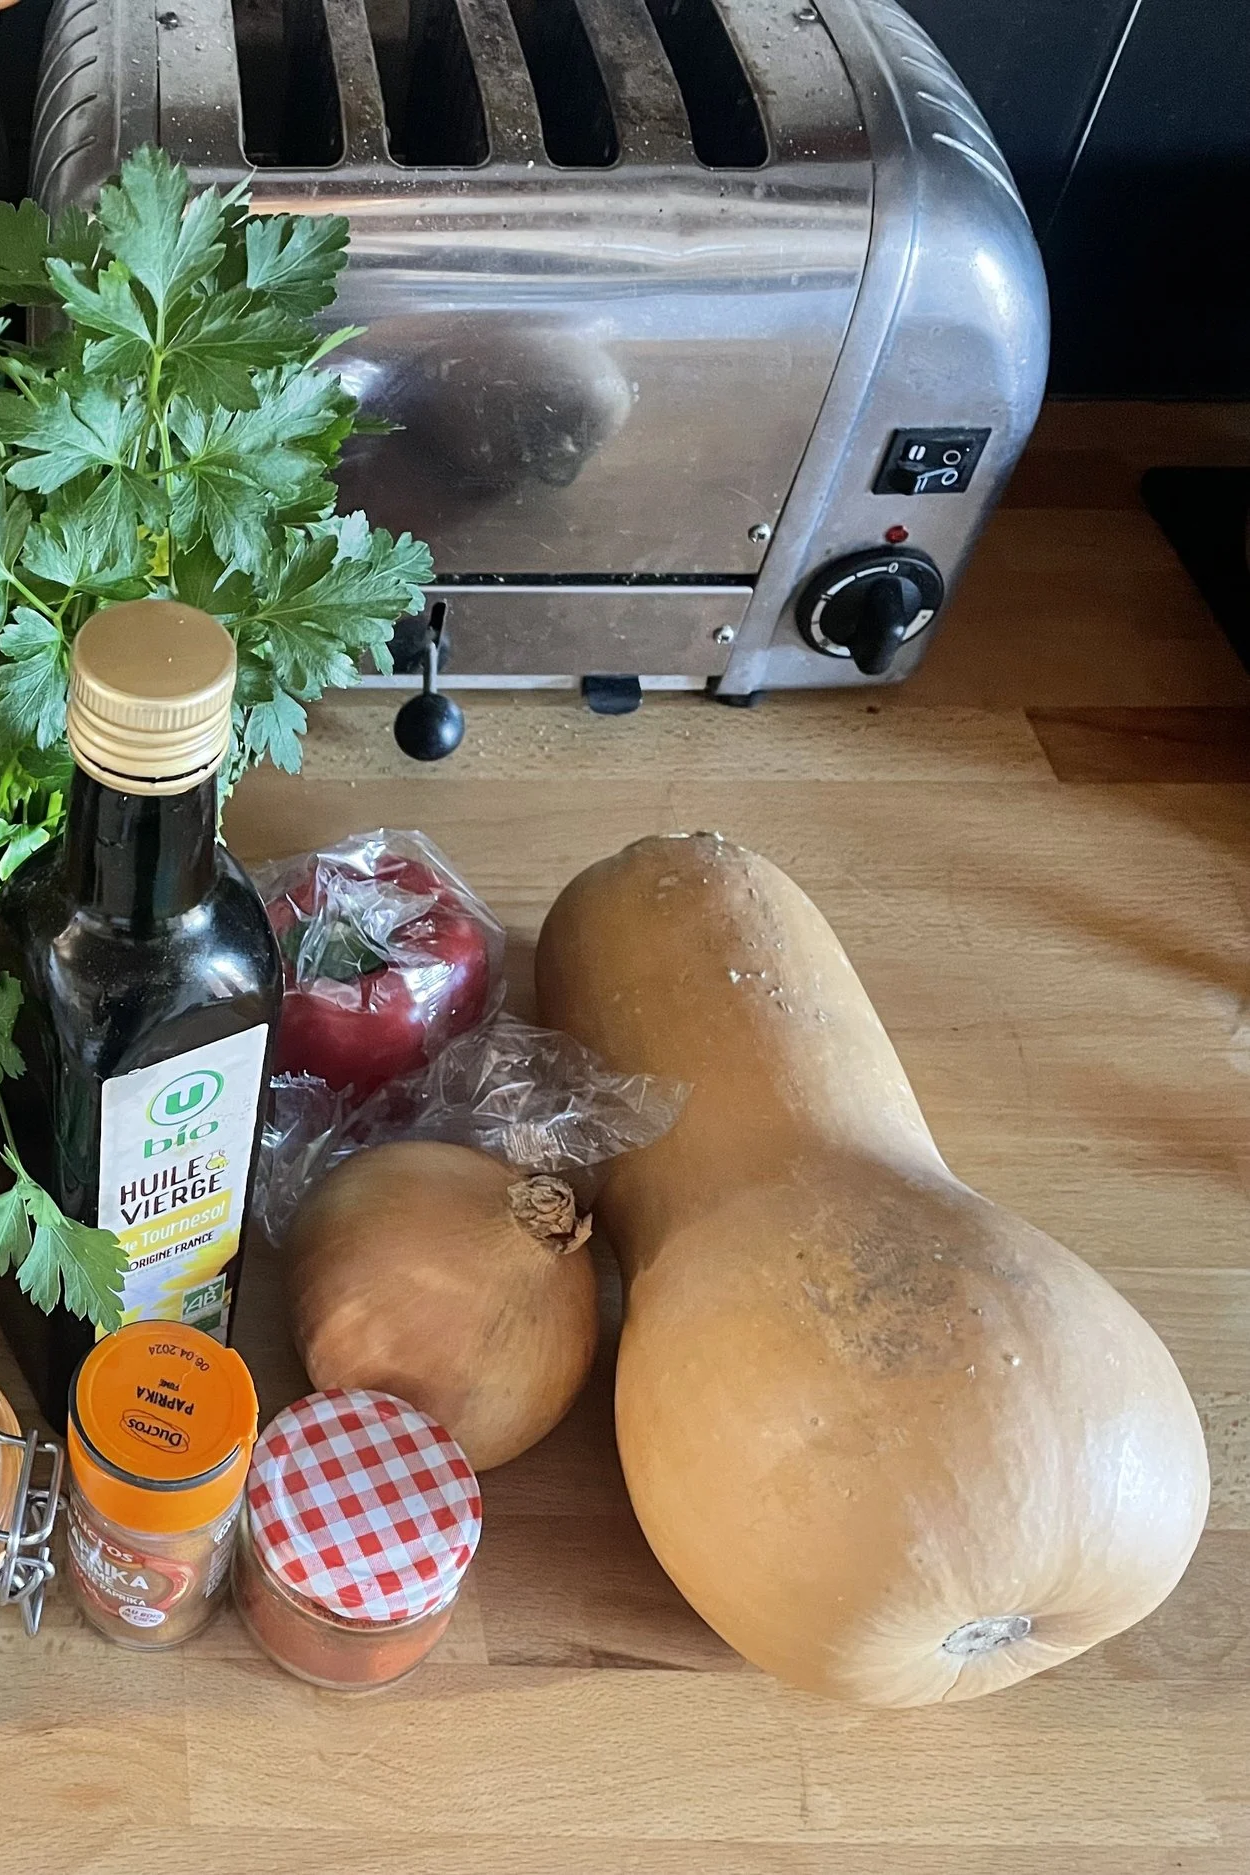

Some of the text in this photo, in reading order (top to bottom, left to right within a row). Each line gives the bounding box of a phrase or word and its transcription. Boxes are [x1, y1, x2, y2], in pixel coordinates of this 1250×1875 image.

[165, 1082, 205, 1114] U
[143, 1120, 219, 1159] bio
[120, 1155, 205, 1206] HUILE
[120, 1170, 226, 1226] VIERGE
[141, 1200, 227, 1247] Tournesol
[129, 1248, 174, 1272] ORIGINE
[174, 1230, 215, 1258] FRANCE
[185, 1290, 219, 1314] AB
[135, 1385, 195, 1416] PAPRIKA
[126, 1418, 183, 1447] Ducros
[71, 1507, 134, 1563] ucros
[70, 1526, 149, 1590] APRIKA
